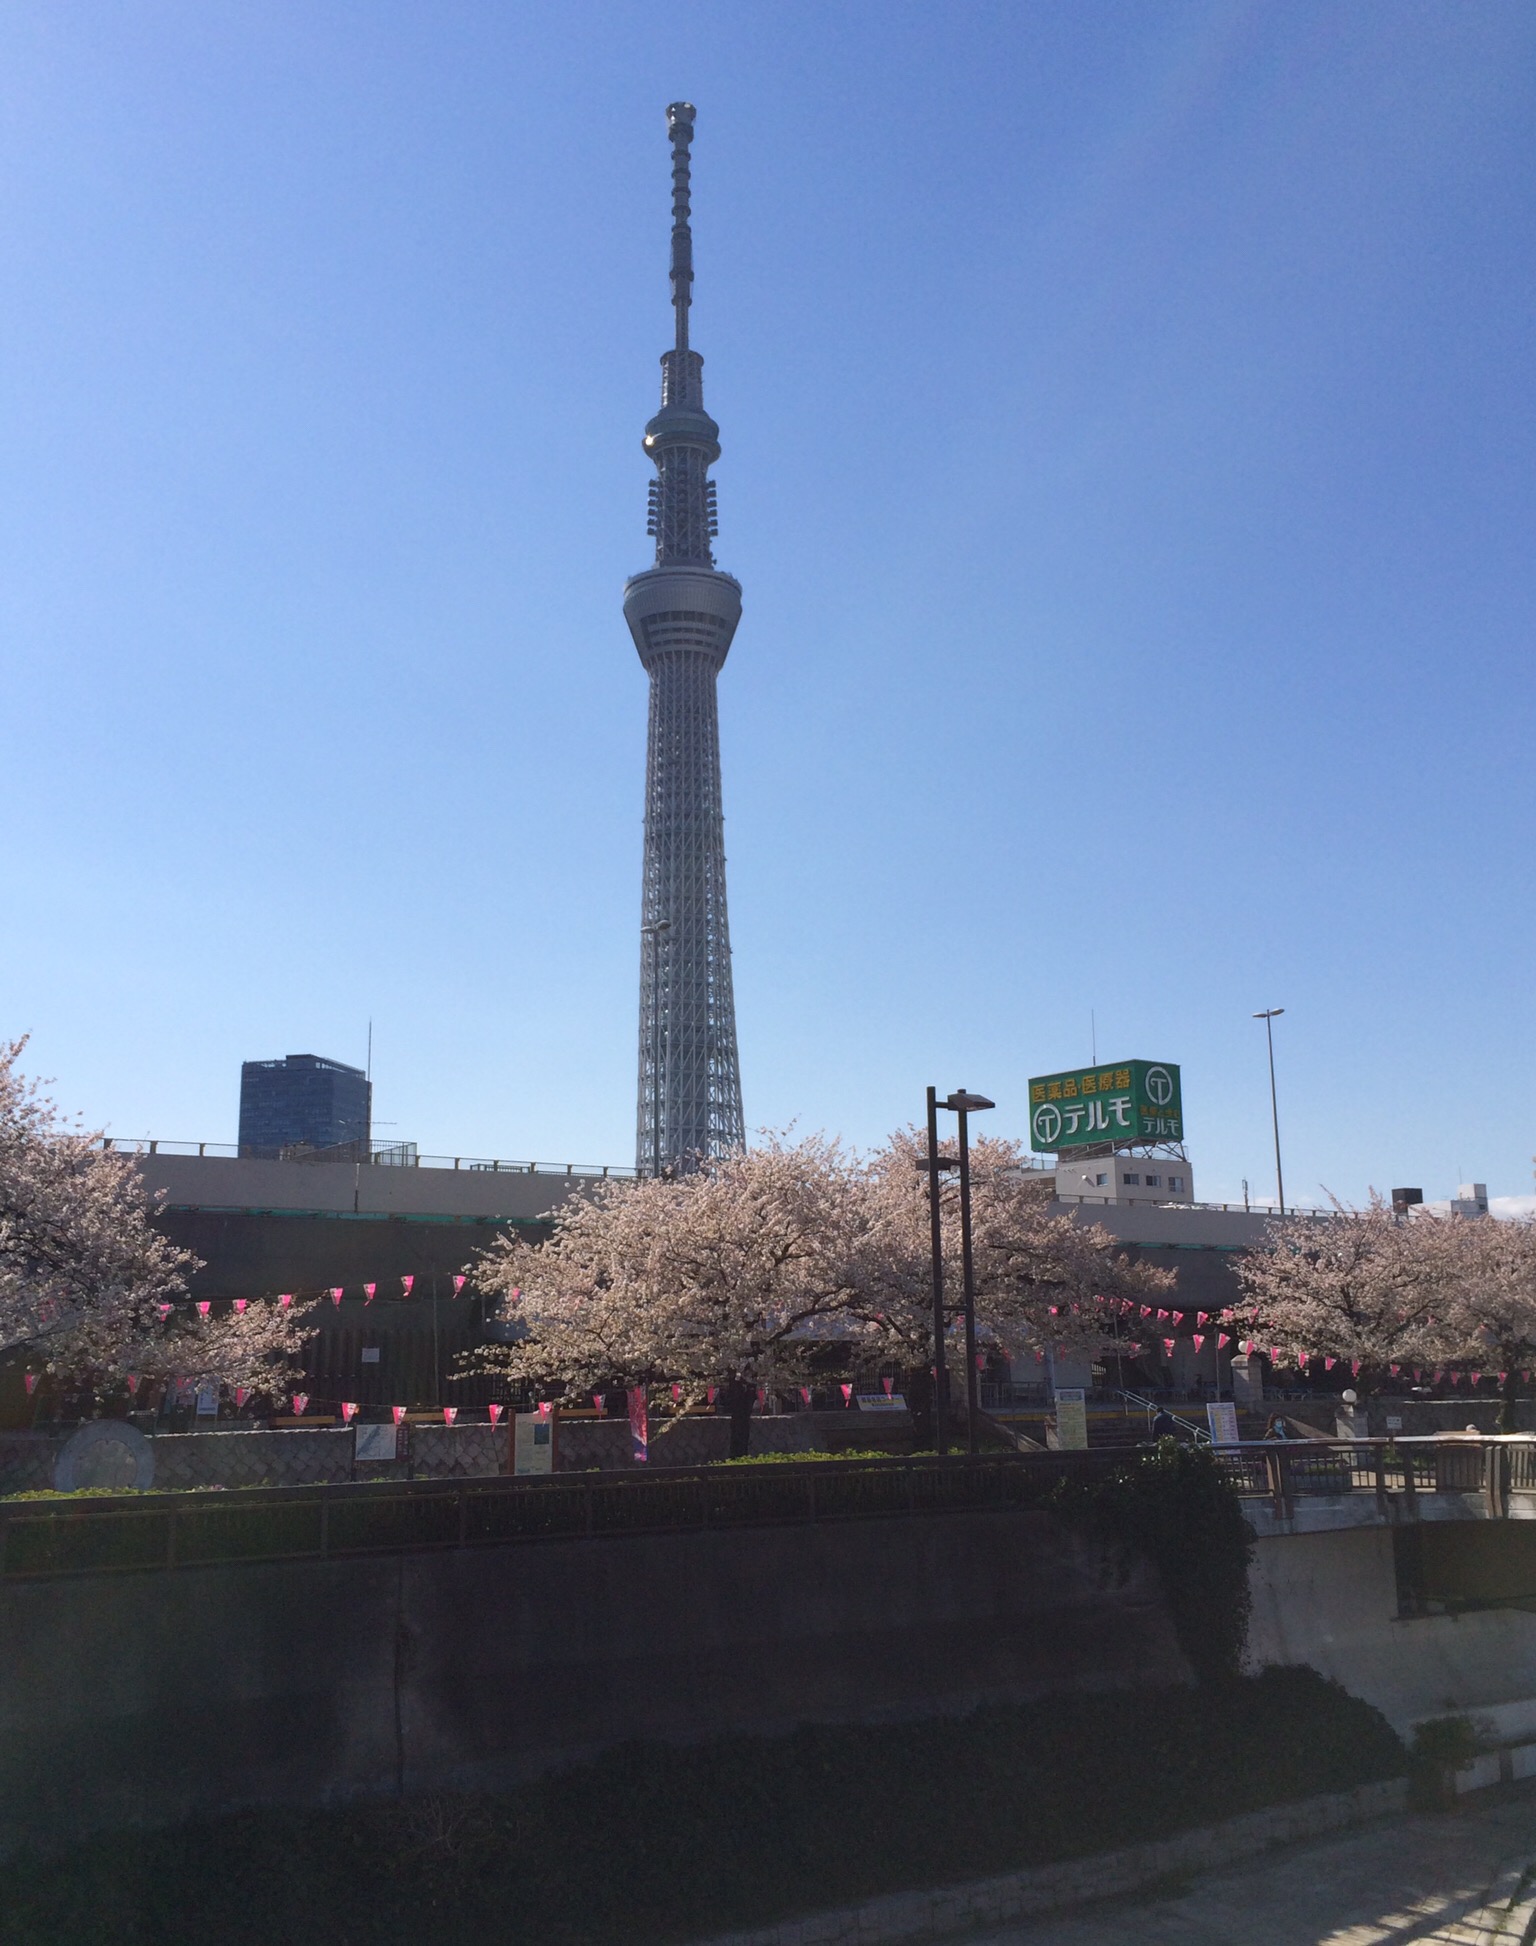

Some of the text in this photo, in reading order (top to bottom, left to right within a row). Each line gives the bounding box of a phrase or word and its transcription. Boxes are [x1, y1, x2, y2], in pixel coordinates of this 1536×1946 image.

[1063, 1096, 1132, 1135] テルモ
[1143, 1116, 1180, 1136] テルモ
